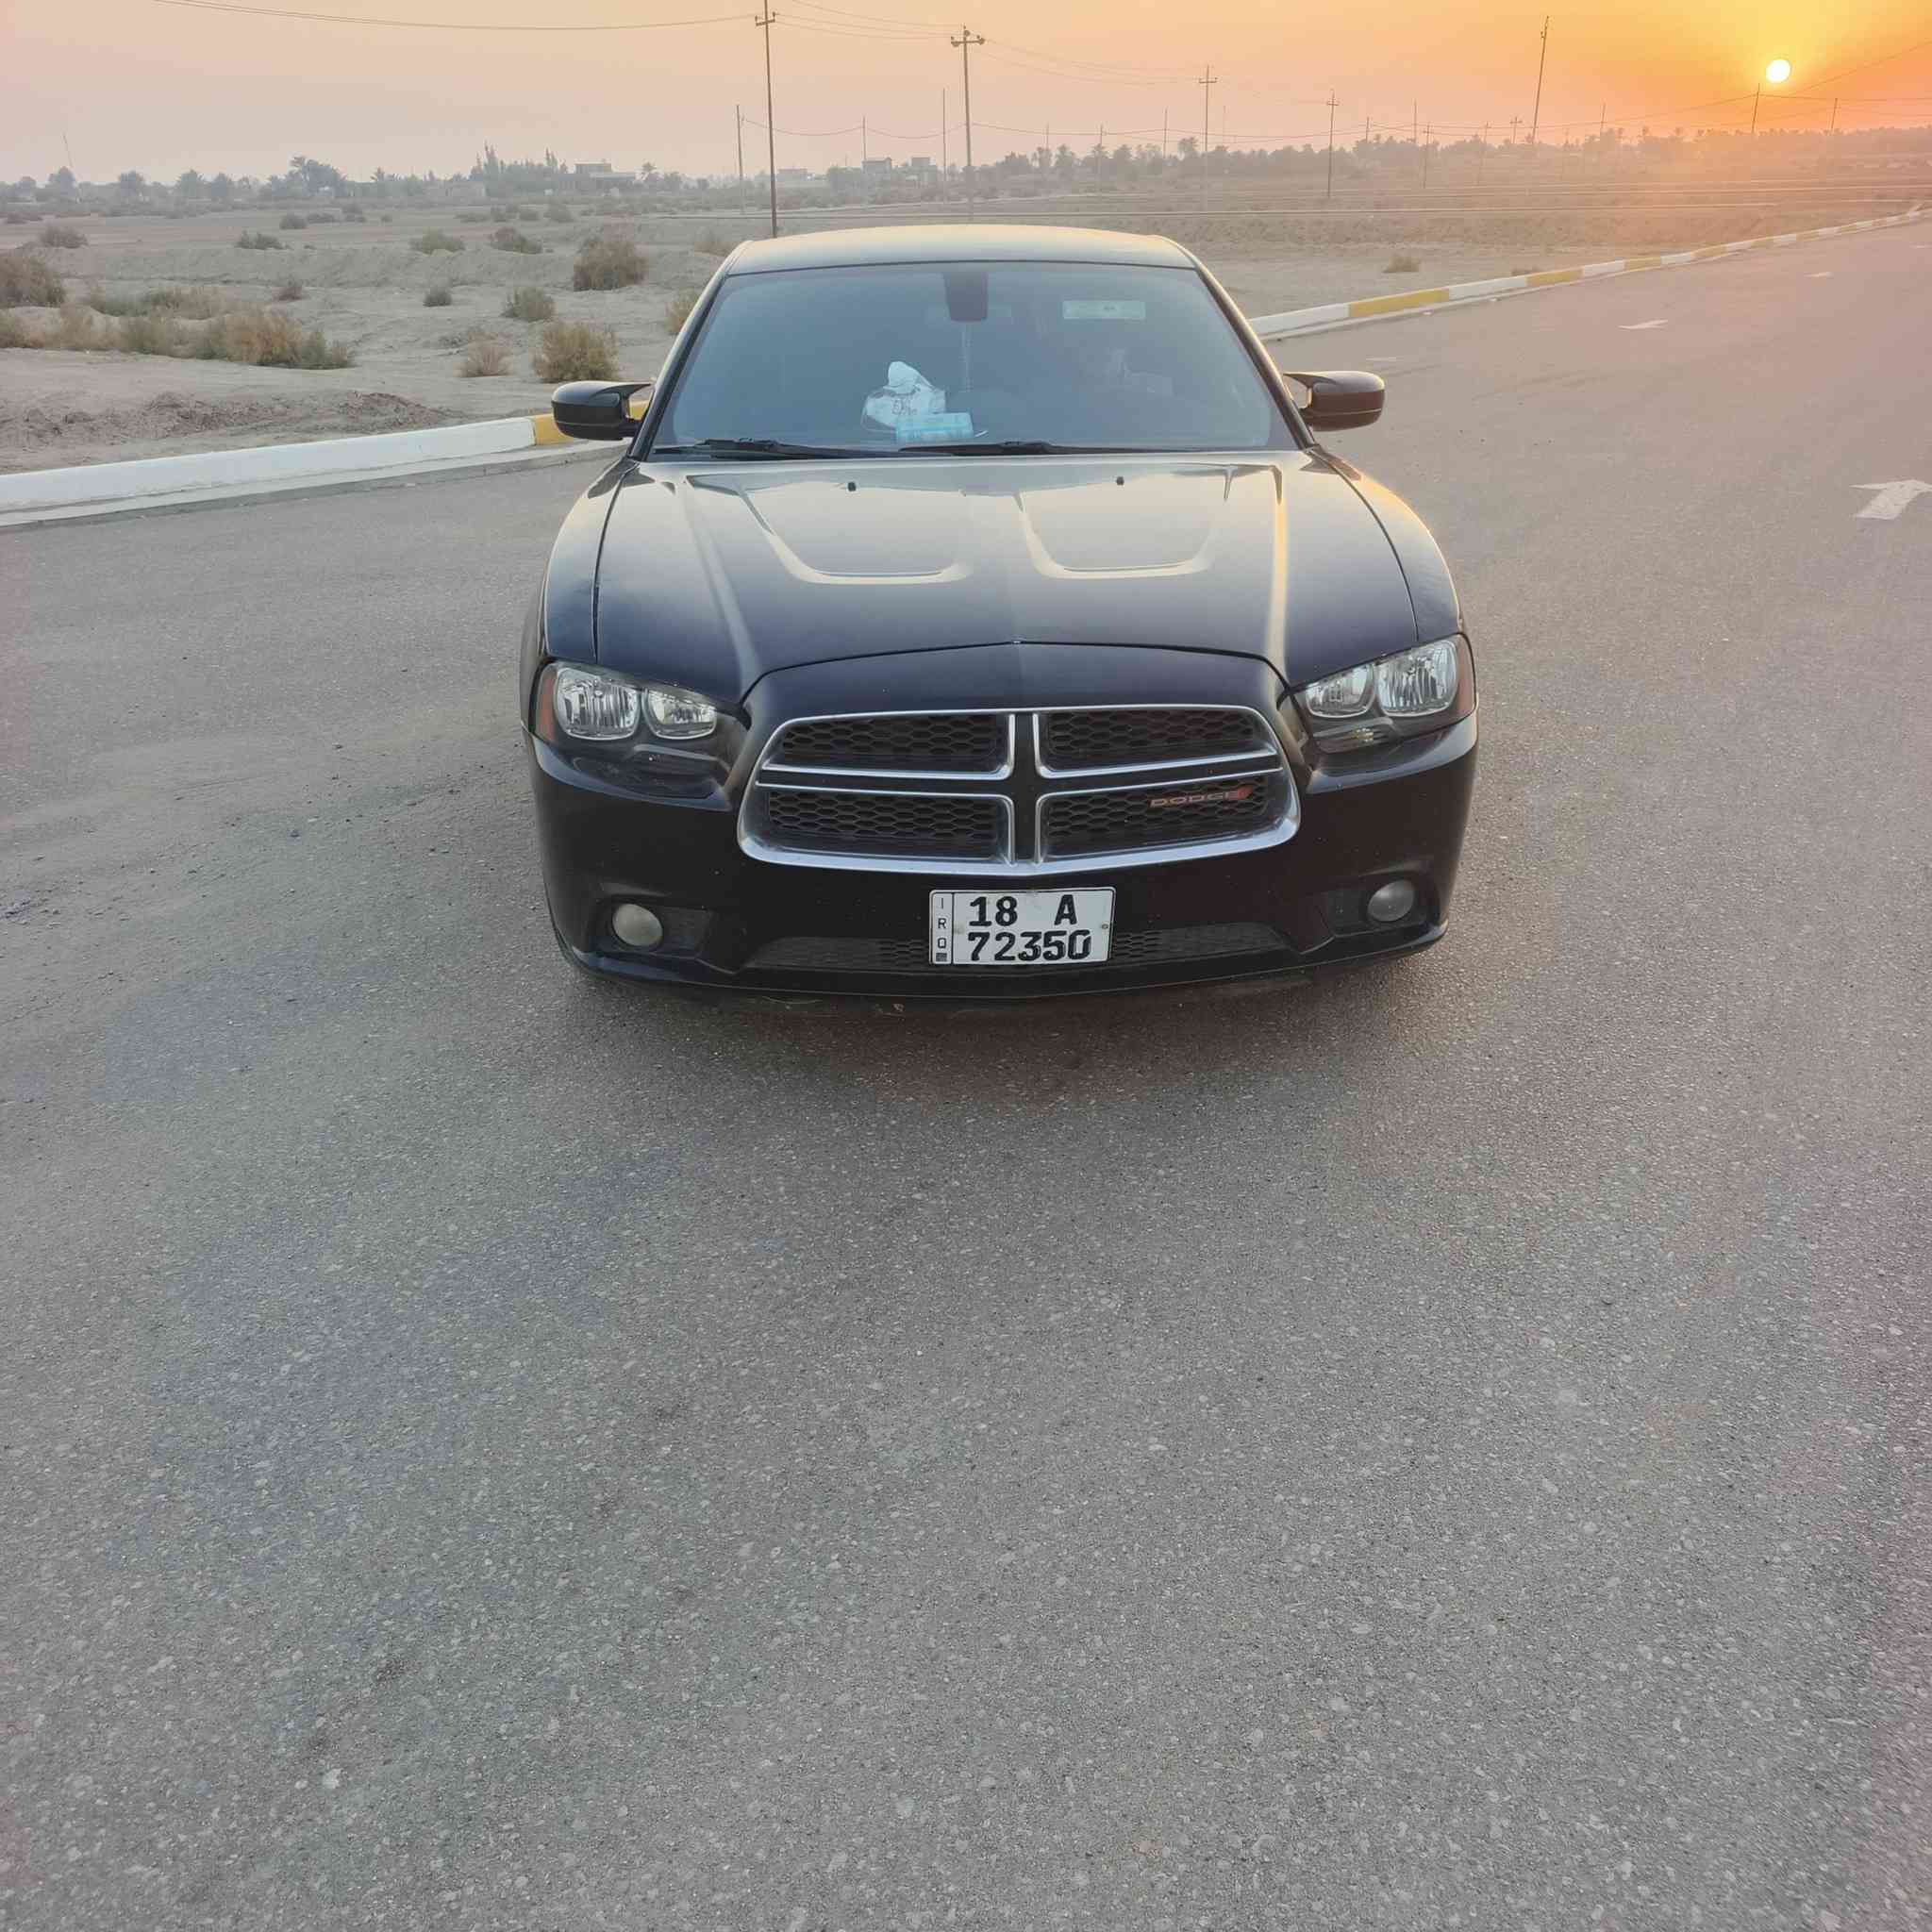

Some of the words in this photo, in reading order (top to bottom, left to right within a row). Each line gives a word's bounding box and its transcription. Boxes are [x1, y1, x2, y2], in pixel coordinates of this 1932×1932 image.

[1150, 791, 1239, 808] DODGE
[969, 895, 1018, 927] 18
[1054, 893, 1077, 926] A
[967, 928, 1091, 962] 72350
